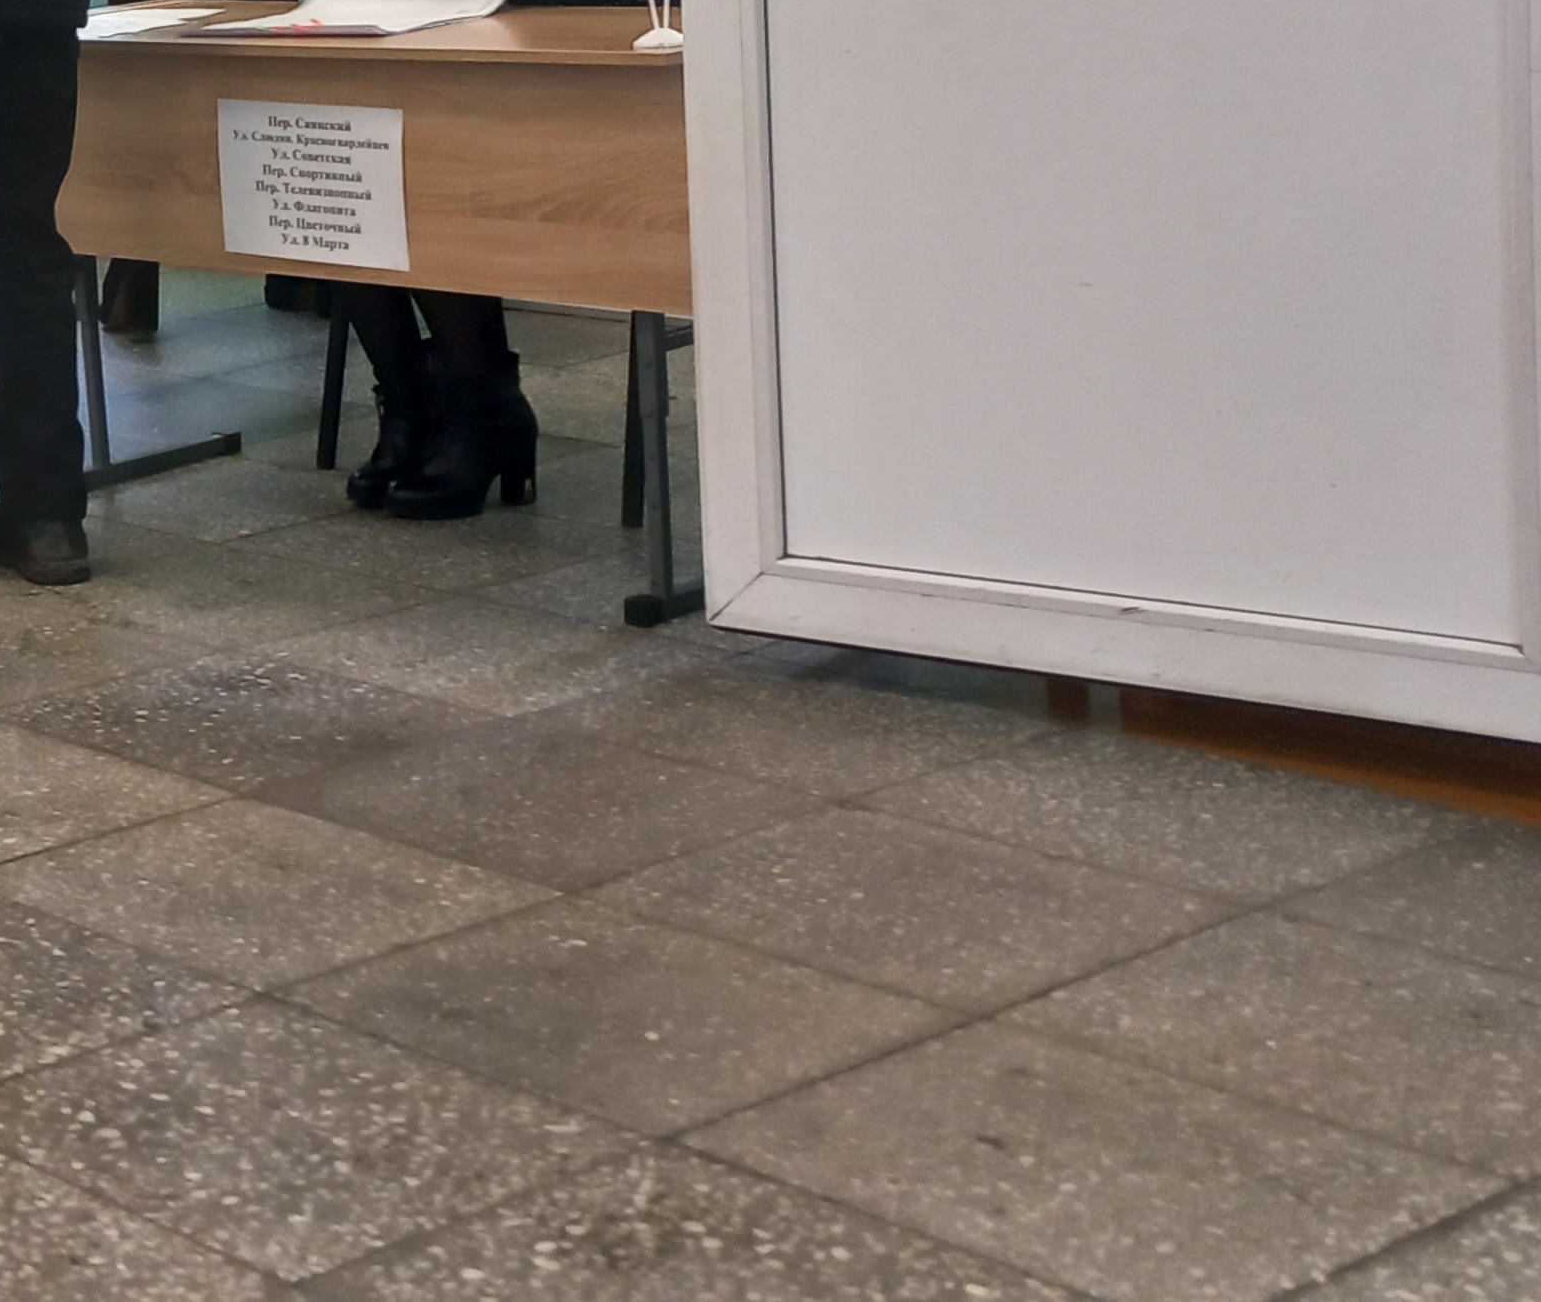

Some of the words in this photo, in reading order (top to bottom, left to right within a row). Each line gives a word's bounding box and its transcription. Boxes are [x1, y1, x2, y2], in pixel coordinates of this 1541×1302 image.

[292, 149, 351, 165] Советская
[290, 166, 362, 183] Спортивный
[282, 182, 372, 200] Телевизионный
[269, 215, 294, 230] Пер.
[296, 218, 361, 234] Цветочный
[312, 235, 349, 252] Марта
